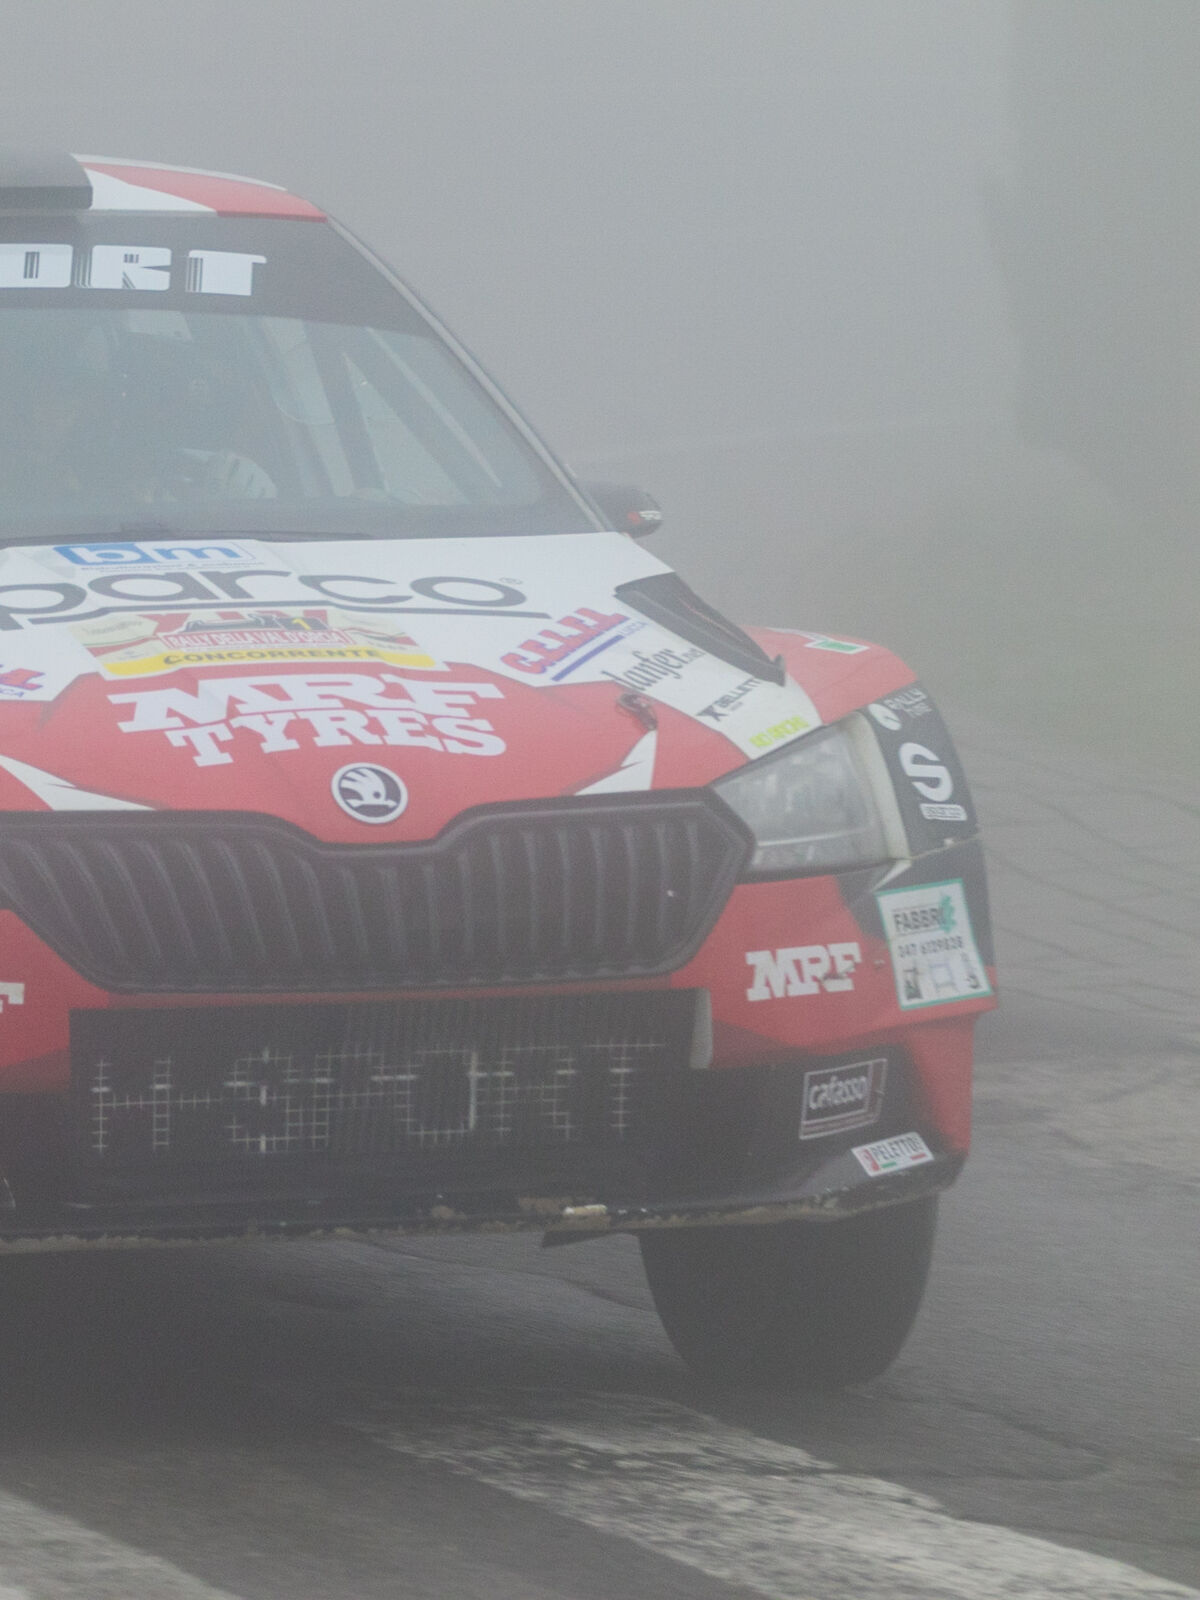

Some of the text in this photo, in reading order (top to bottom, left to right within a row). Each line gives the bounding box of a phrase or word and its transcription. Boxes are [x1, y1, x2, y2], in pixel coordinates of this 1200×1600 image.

[163, 649, 378, 665] CONCORRENTE
[170, 633, 212, 648] RALLY
[215, 632, 258, 646] DELLA
[260, 631, 285, 644] VAL
[107, 672, 506, 732] MRF
[164, 710, 508, 768] TYRES
[745, 941, 862, 1002] MRF
